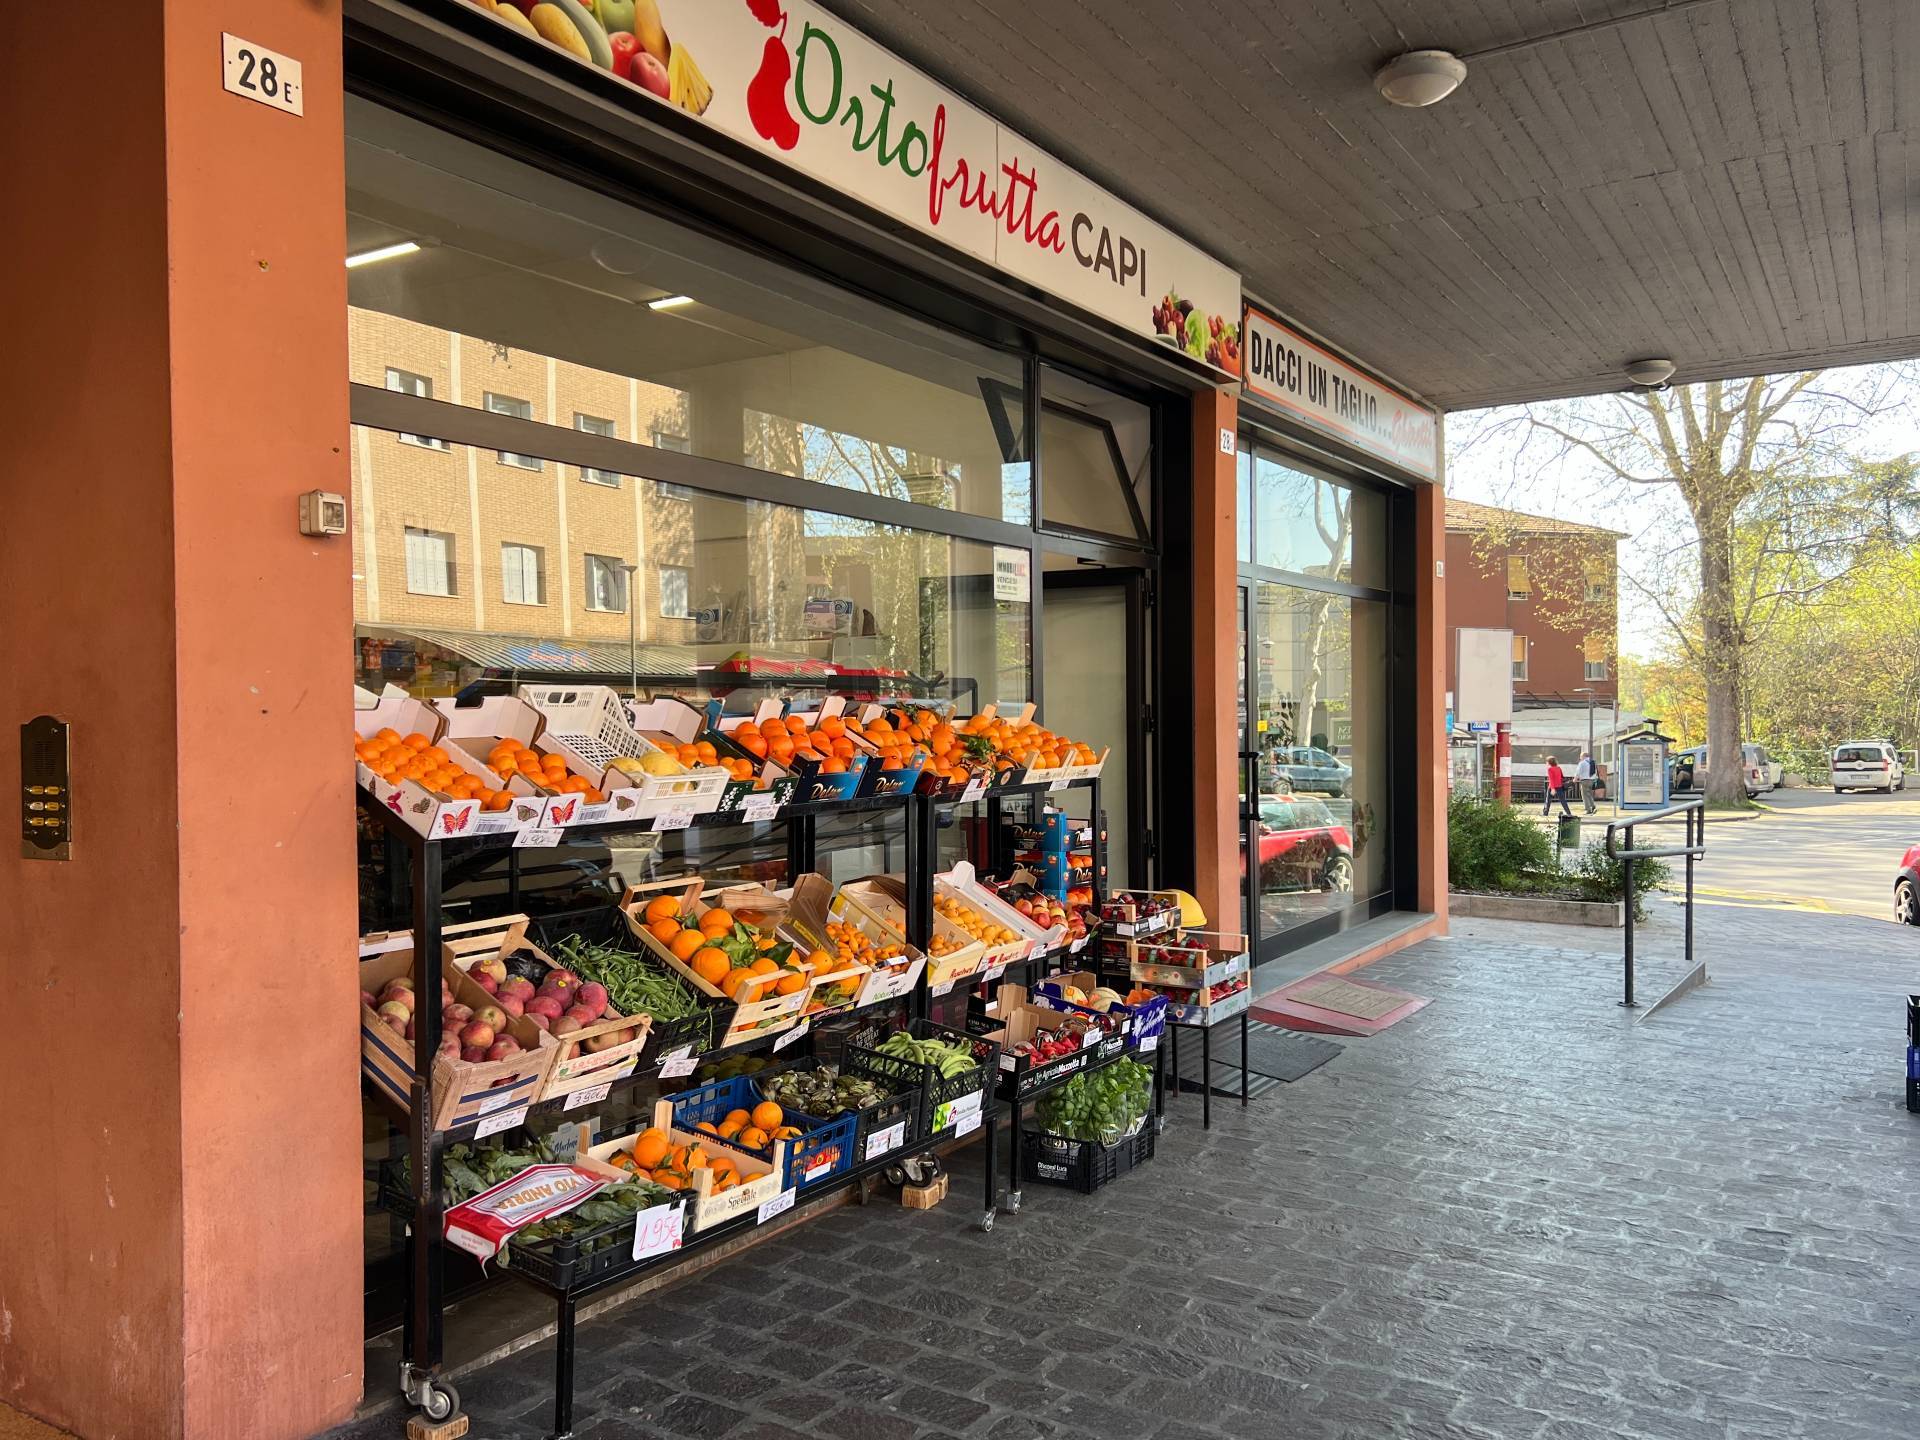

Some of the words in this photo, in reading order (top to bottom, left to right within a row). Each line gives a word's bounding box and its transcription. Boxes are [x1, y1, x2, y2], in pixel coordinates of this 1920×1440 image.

[795, 21, 1065, 254] Ortofrutta
[1071, 212, 1146, 297] CAPI
[1251, 329, 1302, 396] DACCI
[1308, 361, 1327, 408] UN
